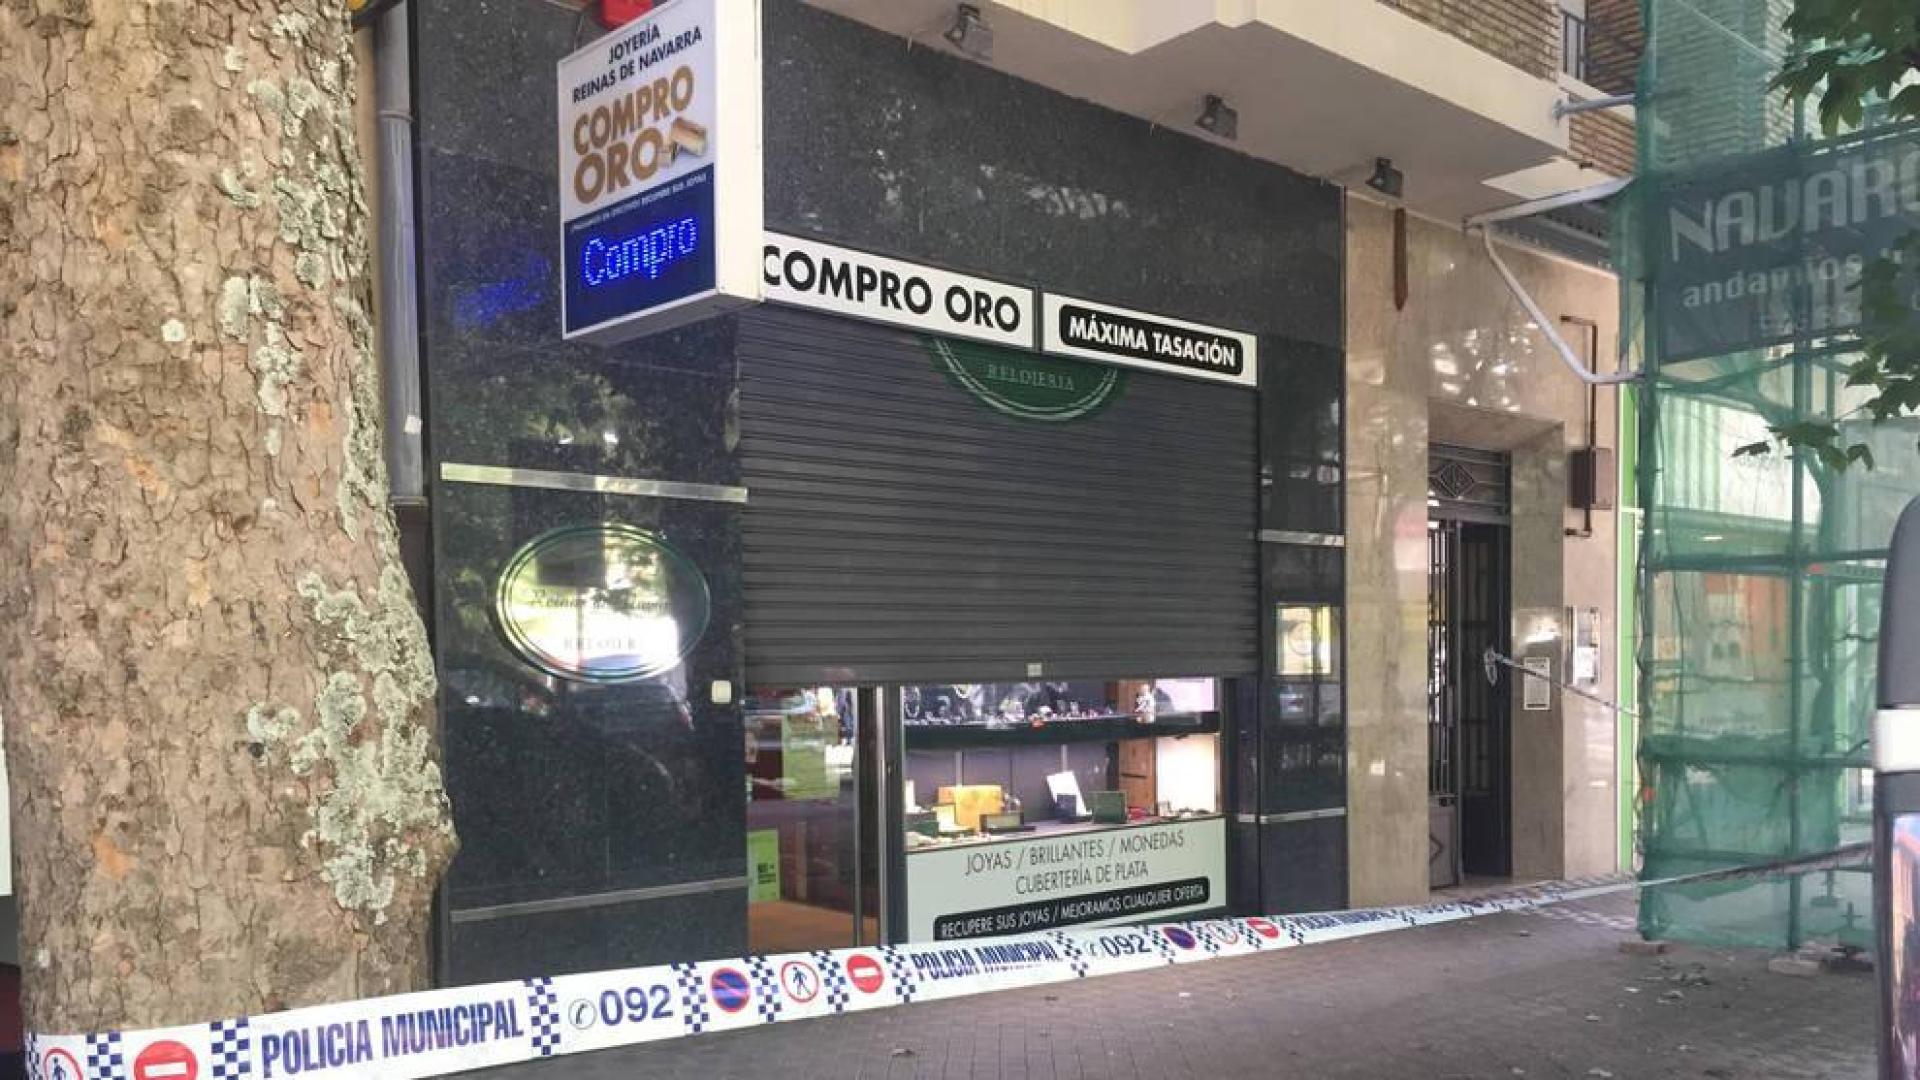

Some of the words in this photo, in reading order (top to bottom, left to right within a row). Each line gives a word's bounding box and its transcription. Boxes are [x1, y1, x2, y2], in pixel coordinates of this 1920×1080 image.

[573, 70, 616, 103] REINAS
[620, 59, 635, 81] DE
[638, 25, 703, 71] NAVARRA
[573, 65, 694, 156] COMPRO
[574, 127, 663, 205] ORO
[584, 217, 697, 286] Compro
[763, 244, 932, 315] COMPRO
[944, 285, 1021, 332] ORO
[1069, 314, 1149, 351] MÁXIMA
[1152, 331, 1236, 367] TASACIÓN
[965, 850, 1012, 876] JOYAS
[1029, 839, 1103, 866] BRILLANTES
[1120, 830, 1184, 854] MONEDAS
[1016, 862, 1092, 895] CUBERTERÍA
[1095, 864, 1112, 883] DE
[1115, 861, 1149, 880] PLATA
[941, 917, 993, 938] RECUPERE
[996, 913, 1015, 931] SUS
[1017, 907, 1050, 928] JOYAS
[1060, 897, 1121, 919] MEJORAMOS
[1122, 890, 1172, 911] CUALQUIER
[1100, 933, 1153, 959] 092
[600, 984, 673, 1026] 092
[262, 1020, 372, 1079] POLICIA
[381, 998, 524, 1058] MUNICIPAL
